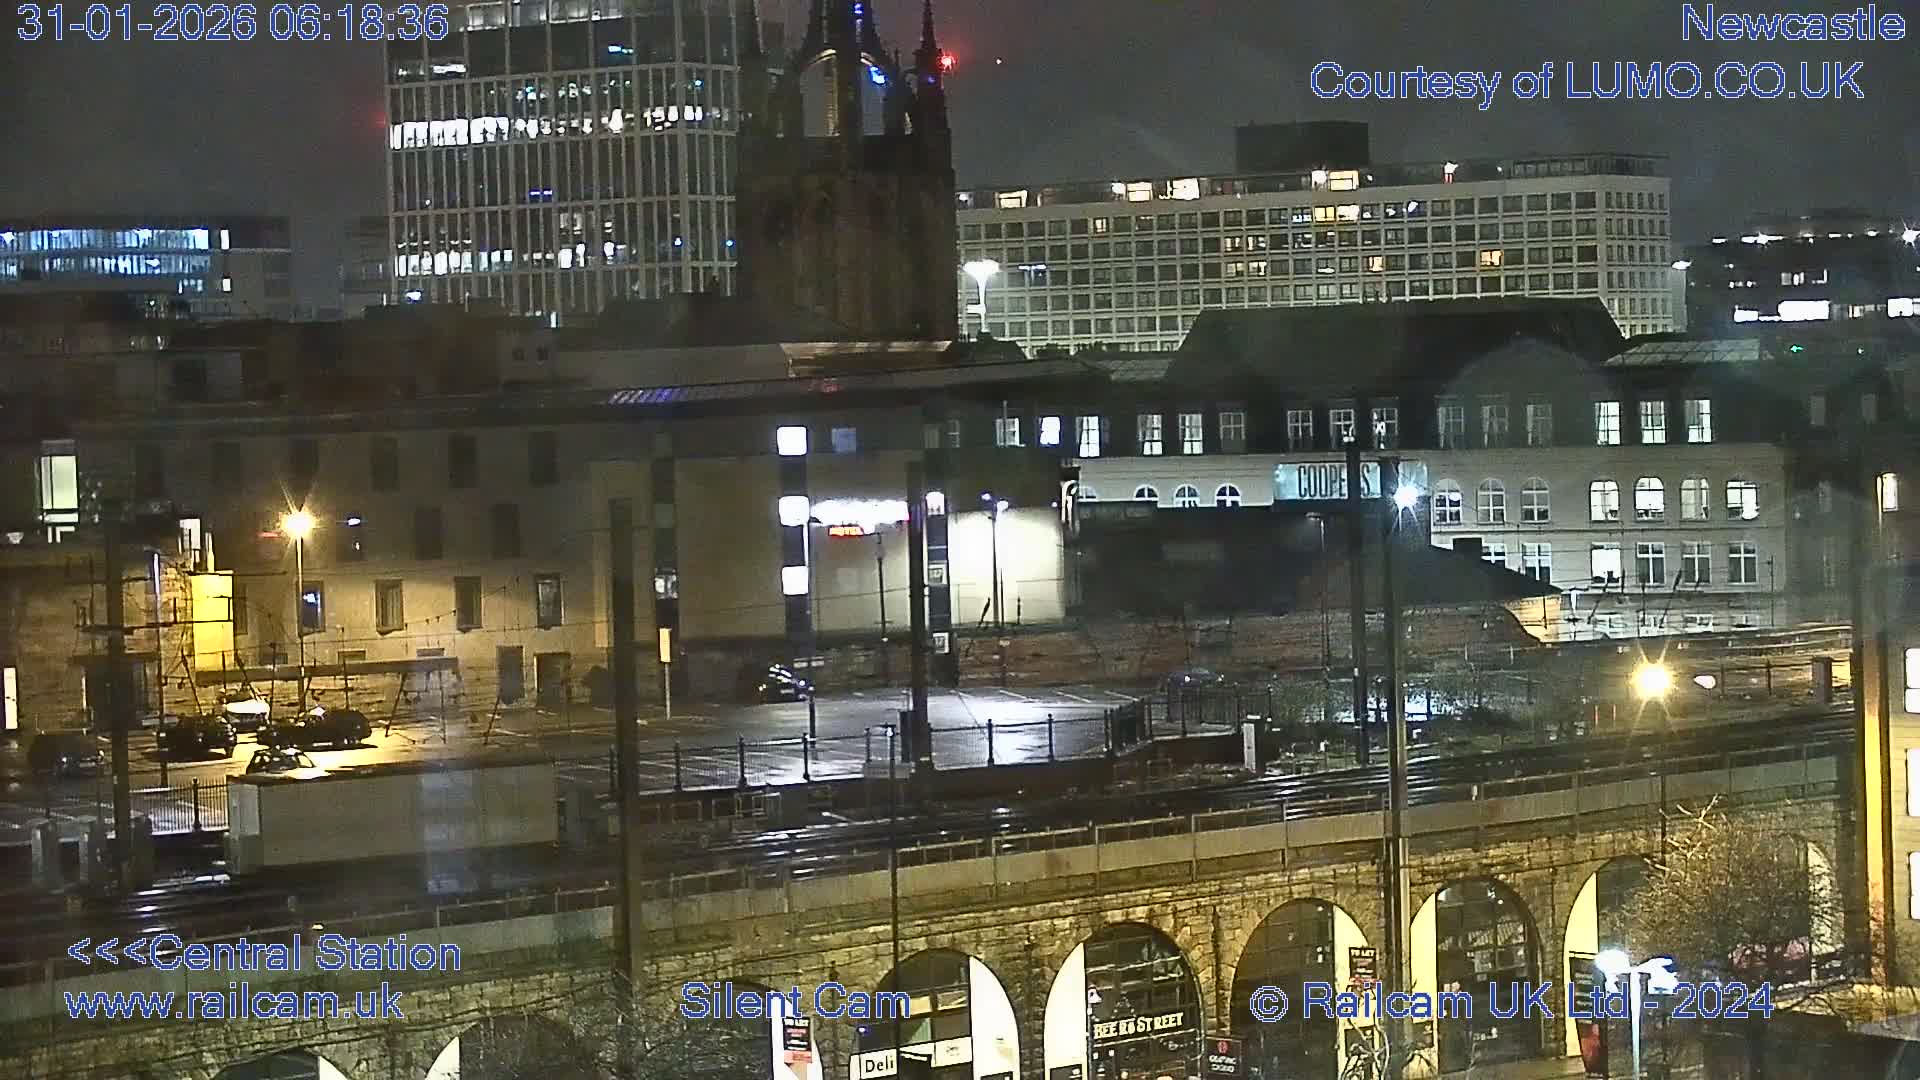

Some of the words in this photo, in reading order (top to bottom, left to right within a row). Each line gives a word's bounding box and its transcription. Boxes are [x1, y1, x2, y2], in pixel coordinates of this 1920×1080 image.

[1298, 463, 1371, 498] COOPES
[1136, 1012, 1184, 1033] STREET
[865, 1055, 894, 1073] Deli
